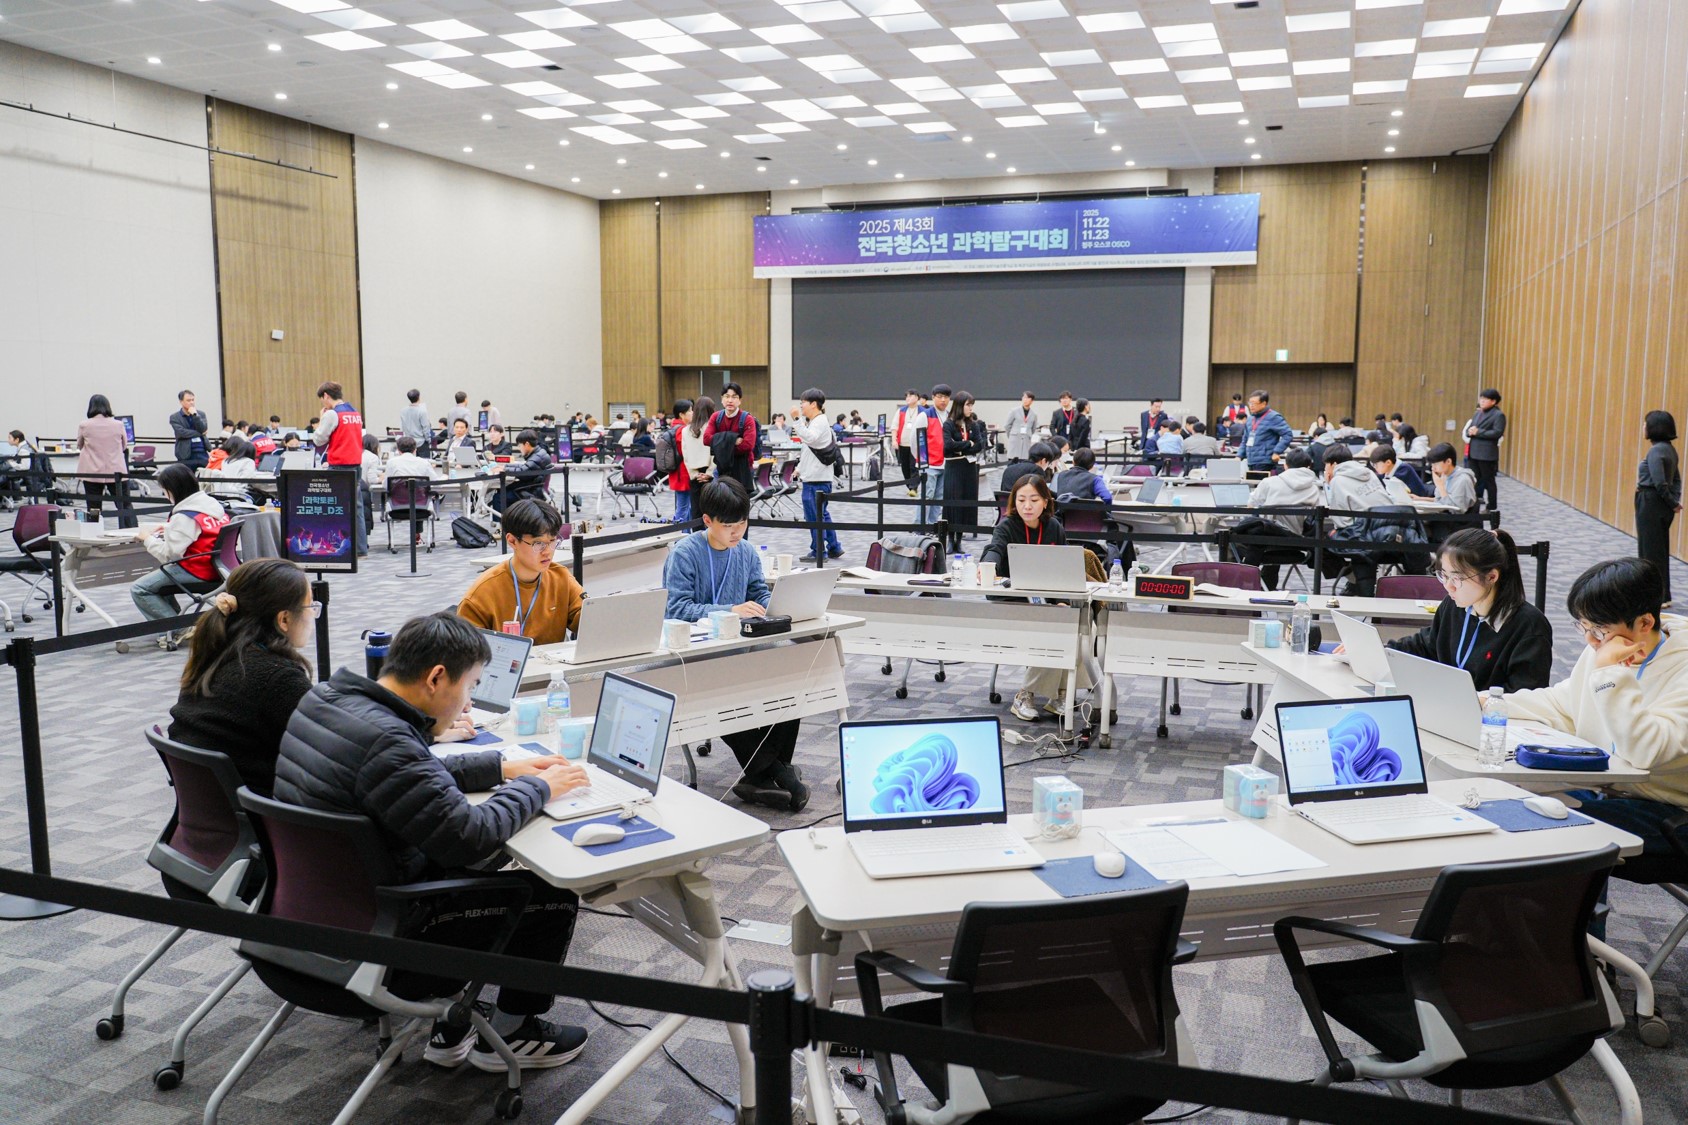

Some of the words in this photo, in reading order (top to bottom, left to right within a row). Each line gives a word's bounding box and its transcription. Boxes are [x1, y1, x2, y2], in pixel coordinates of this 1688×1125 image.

[1082, 209, 1099, 217] 2025
[859, 220, 890, 234] 2025
[893, 216, 934, 233] 제43회
[1082, 217, 1110, 228] 11.22
[1082, 229, 1109, 240] 11.23
[858, 231, 948, 257] 전국청소년
[952, 228, 1069, 253] 과학탐구대회
[342, 415, 362, 425] STAF
[302, 496, 337, 505] [과학토론]
[296, 506, 344, 515] 고교부_D조
[1140, 581, 1185, 595] 00:00:00
